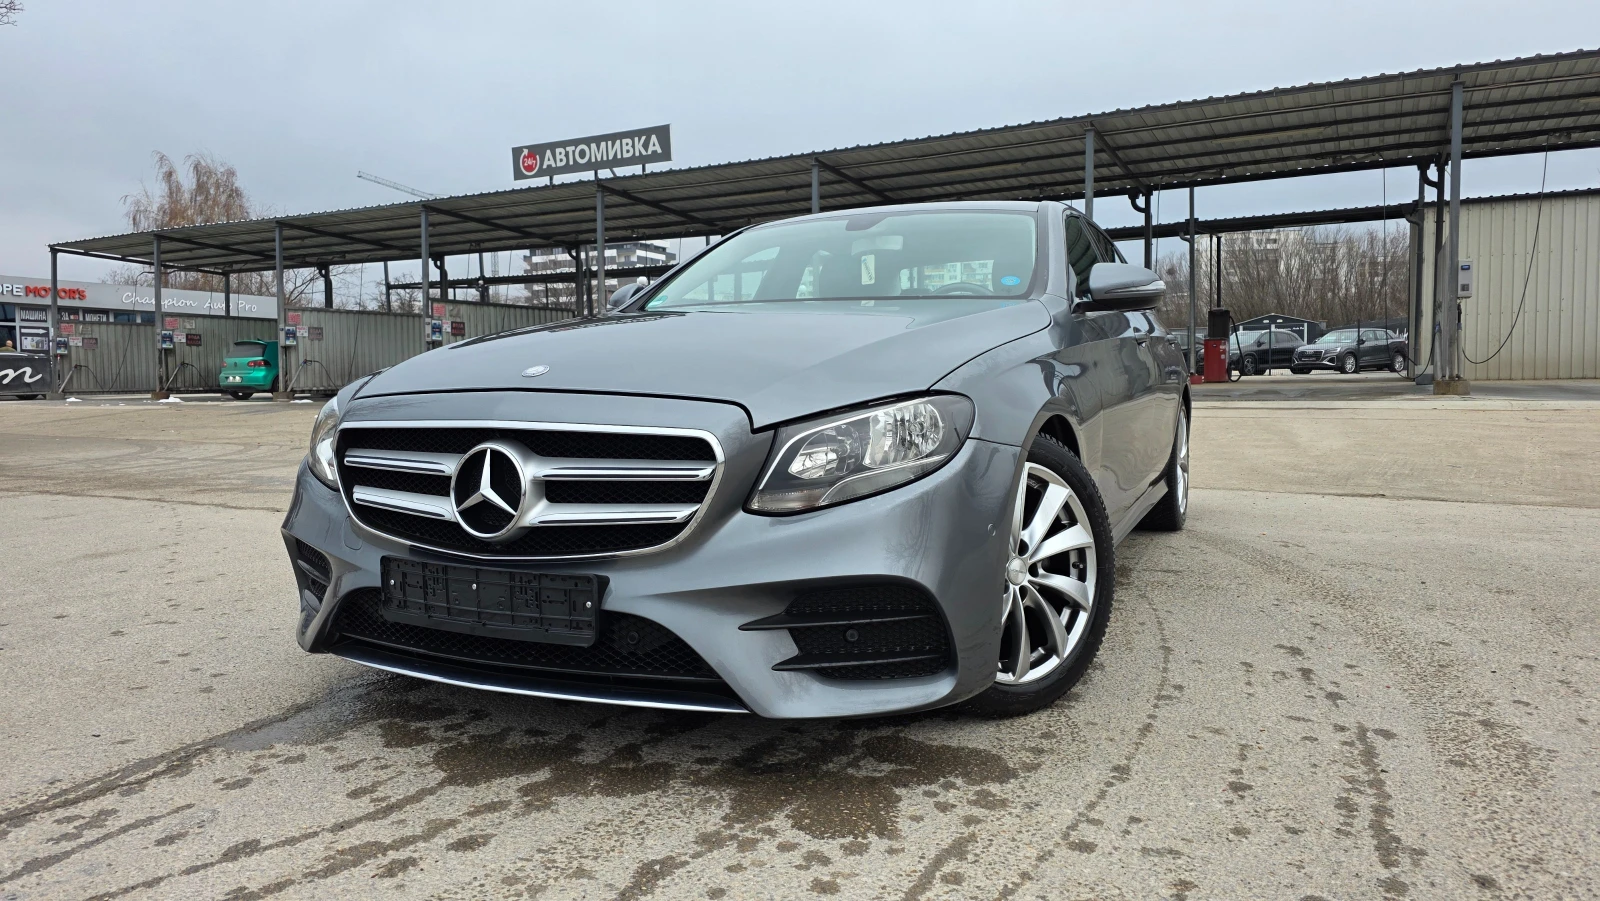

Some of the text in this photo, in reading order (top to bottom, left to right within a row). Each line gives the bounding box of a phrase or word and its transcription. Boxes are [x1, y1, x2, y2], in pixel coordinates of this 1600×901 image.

[542, 134, 662, 169] АВТОМИВКА
[0, 283, 87, 300] PE MOOR'S
[238, 300, 257, 312] Pro
[20, 309, 47, 320] МАШИНА
